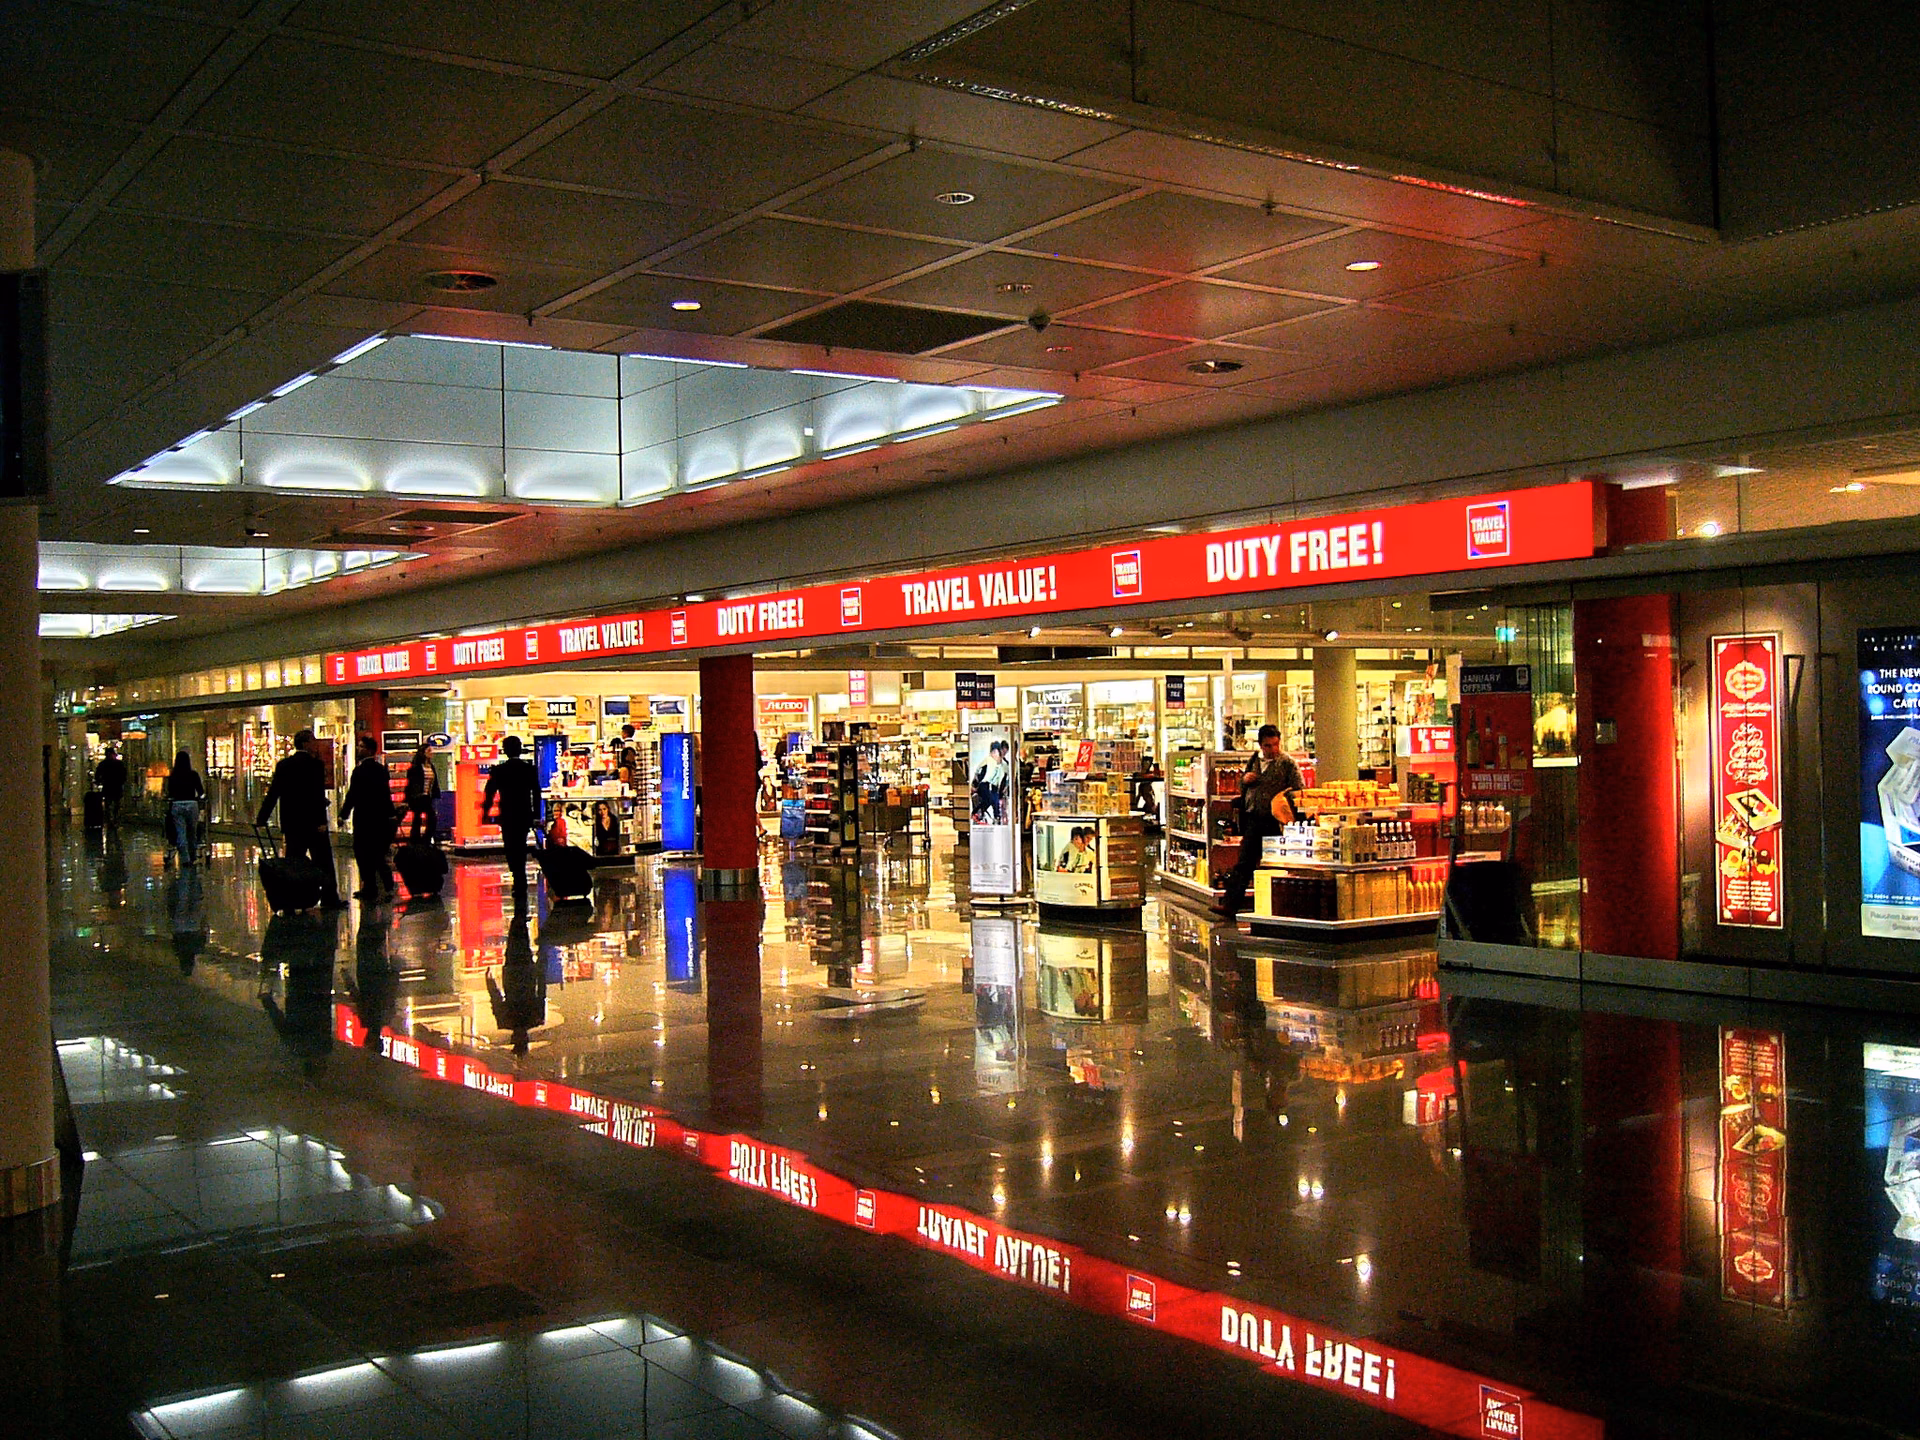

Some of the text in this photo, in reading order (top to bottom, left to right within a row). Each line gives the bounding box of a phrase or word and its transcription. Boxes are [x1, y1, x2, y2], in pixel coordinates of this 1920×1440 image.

[1471, 515, 1505, 532] TRAVEL
[1474, 530, 1503, 545] VALUE
[1206, 521, 1383, 583] DUTY FREE!
[1114, 562, 1139, 575] TRAVEL
[1116, 573, 1137, 586] VALUE
[902, 576, 975, 616] TRAVEL
[979, 565, 1057, 608] VALUE!
[717, 604, 755, 637] DUTY
[758, 597, 804, 632] FREE!
[559, 625, 600, 654] TRAVEL
[601, 620, 644, 649] VALUE!
[453, 641, 477, 666] DUTY
[476, 637, 505, 664] FREE!
[356, 654, 383, 677] TRAVEL
[1880, 668, 1898, 679] THE
[1463, 673, 1500, 683] JANUARY
[1462, 683, 1492, 692] OFFERS
[1867, 684, 1903, 694] ROUND
[765, 701, 804, 711] SHISEIDO
[682, 738, 690, 800] Promotion
